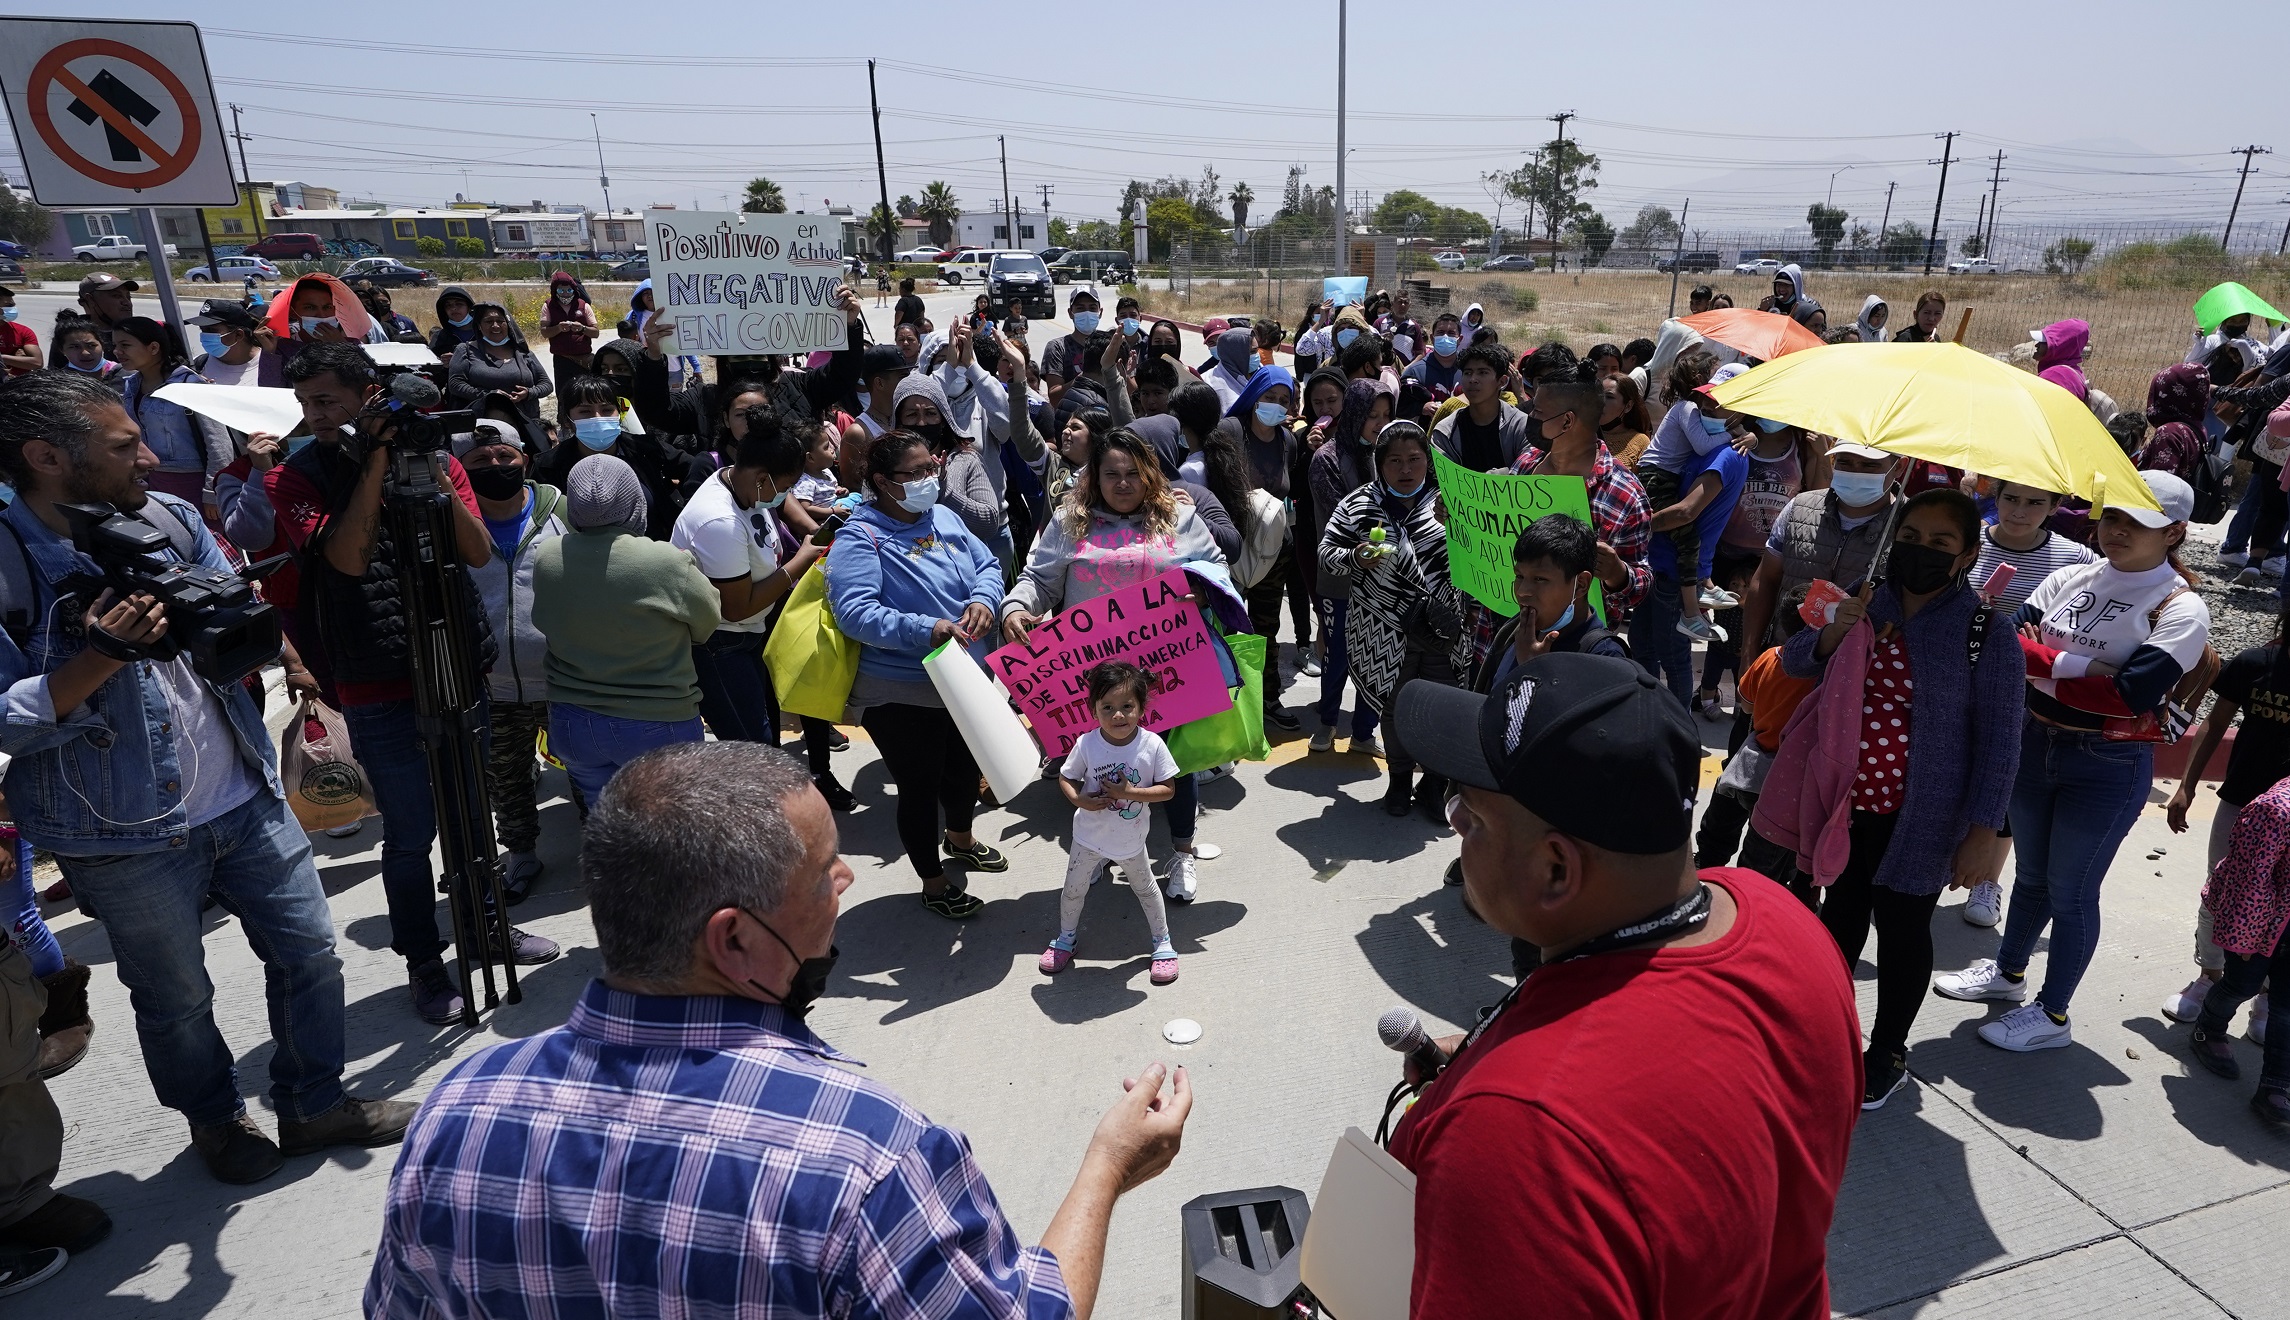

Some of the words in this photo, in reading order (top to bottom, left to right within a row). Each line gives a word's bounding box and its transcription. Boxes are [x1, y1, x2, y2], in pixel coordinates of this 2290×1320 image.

[797, 224, 818, 238] en
[667, 273, 843, 310] NEGATIVO
[675, 313, 729, 350] EN
[737, 312, 847, 351] COVID
[1436, 458, 1449, 484] SI
[1455, 468, 1553, 510] ESTAMOS
[1744, 481, 1765, 494] THE
[1768, 483, 1796, 497] BEST
[1000, 608, 1094, 676] ALTO
[1107, 598, 1125, 622] A
[1142, 580, 1178, 611] LA
[1972, 614, 1986, 632] OF
[2050, 590, 2134, 634] RF
[1011, 609, 1188, 701] DISCRIMINACCION
[1969, 641, 1981, 669] SW
[2042, 623, 2067, 639] NEW
[2071, 634, 2108, 651] YORK
[1026, 689, 1056, 714] DE
[1138, 631, 1207, 670] AMERICA
[2250, 687, 2290, 709] LAT
